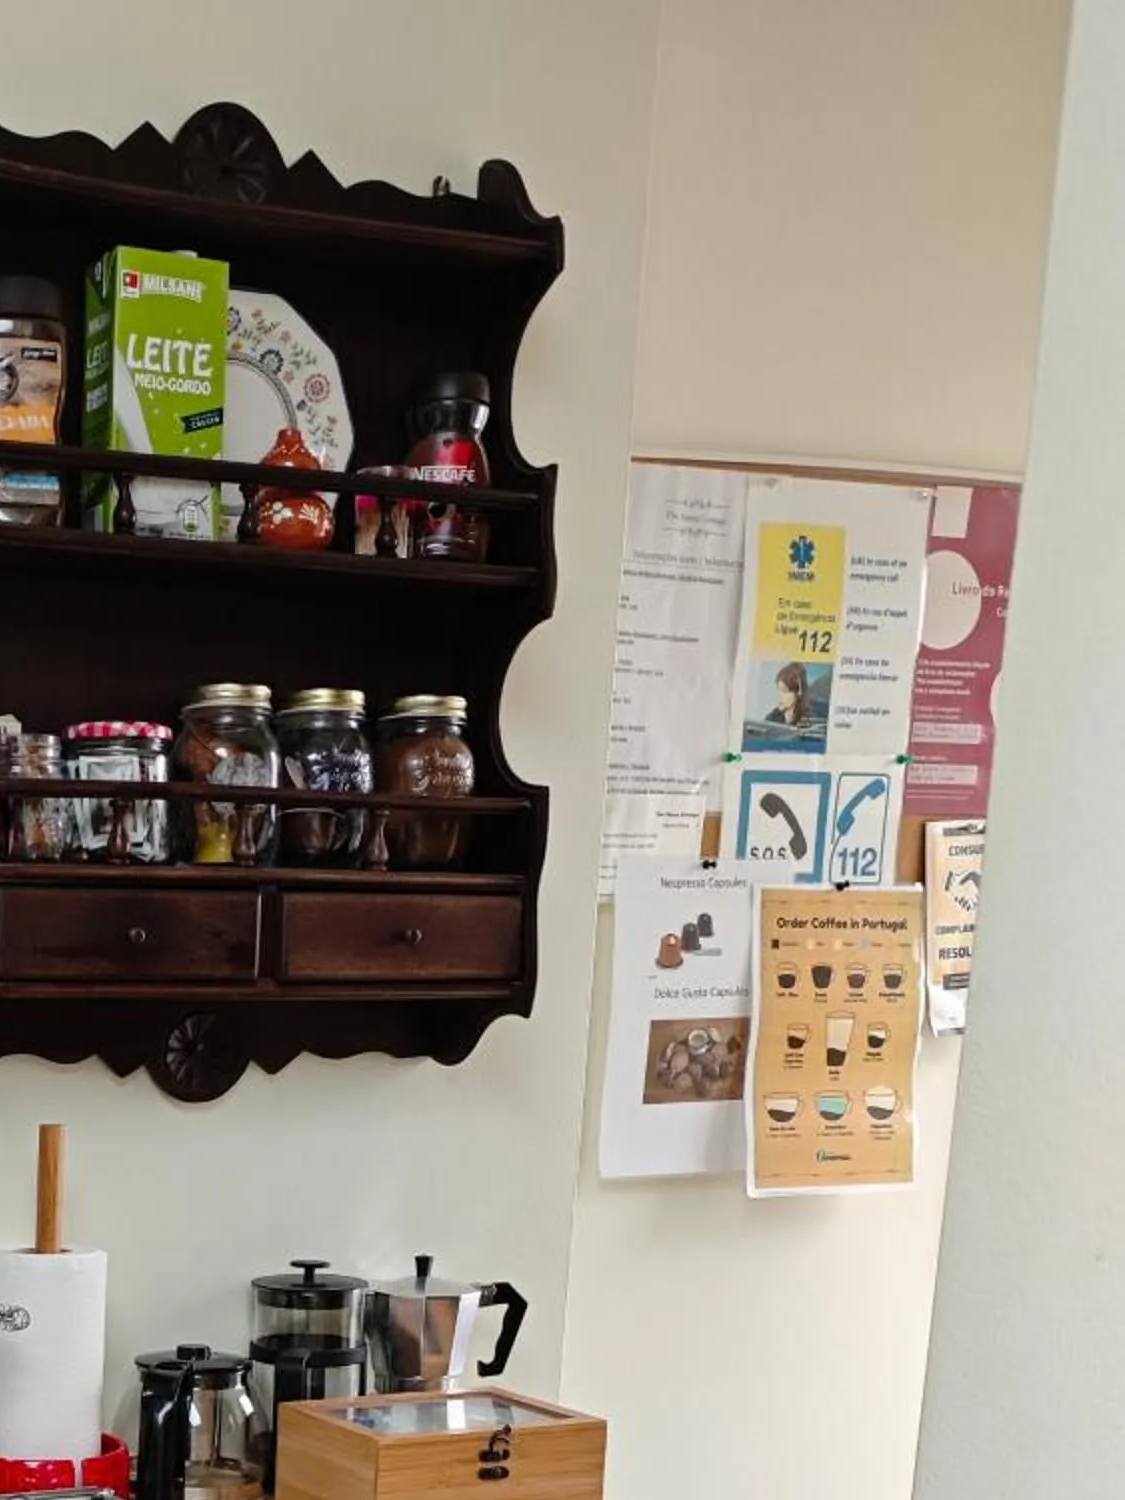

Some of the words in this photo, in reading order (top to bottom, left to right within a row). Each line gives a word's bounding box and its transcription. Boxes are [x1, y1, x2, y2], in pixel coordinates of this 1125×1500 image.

[126, 332, 214, 377] LEITE
[134, 372, 212, 397] MEIO-GORDO
[799, 630, 832, 654] 112
[838, 847, 877, 876] 112
[776, 917, 808, 929] Order
[811, 917, 848, 929] Coffee
[850, 917, 860, 929] in
[861, 918, 908, 933] Portugal
